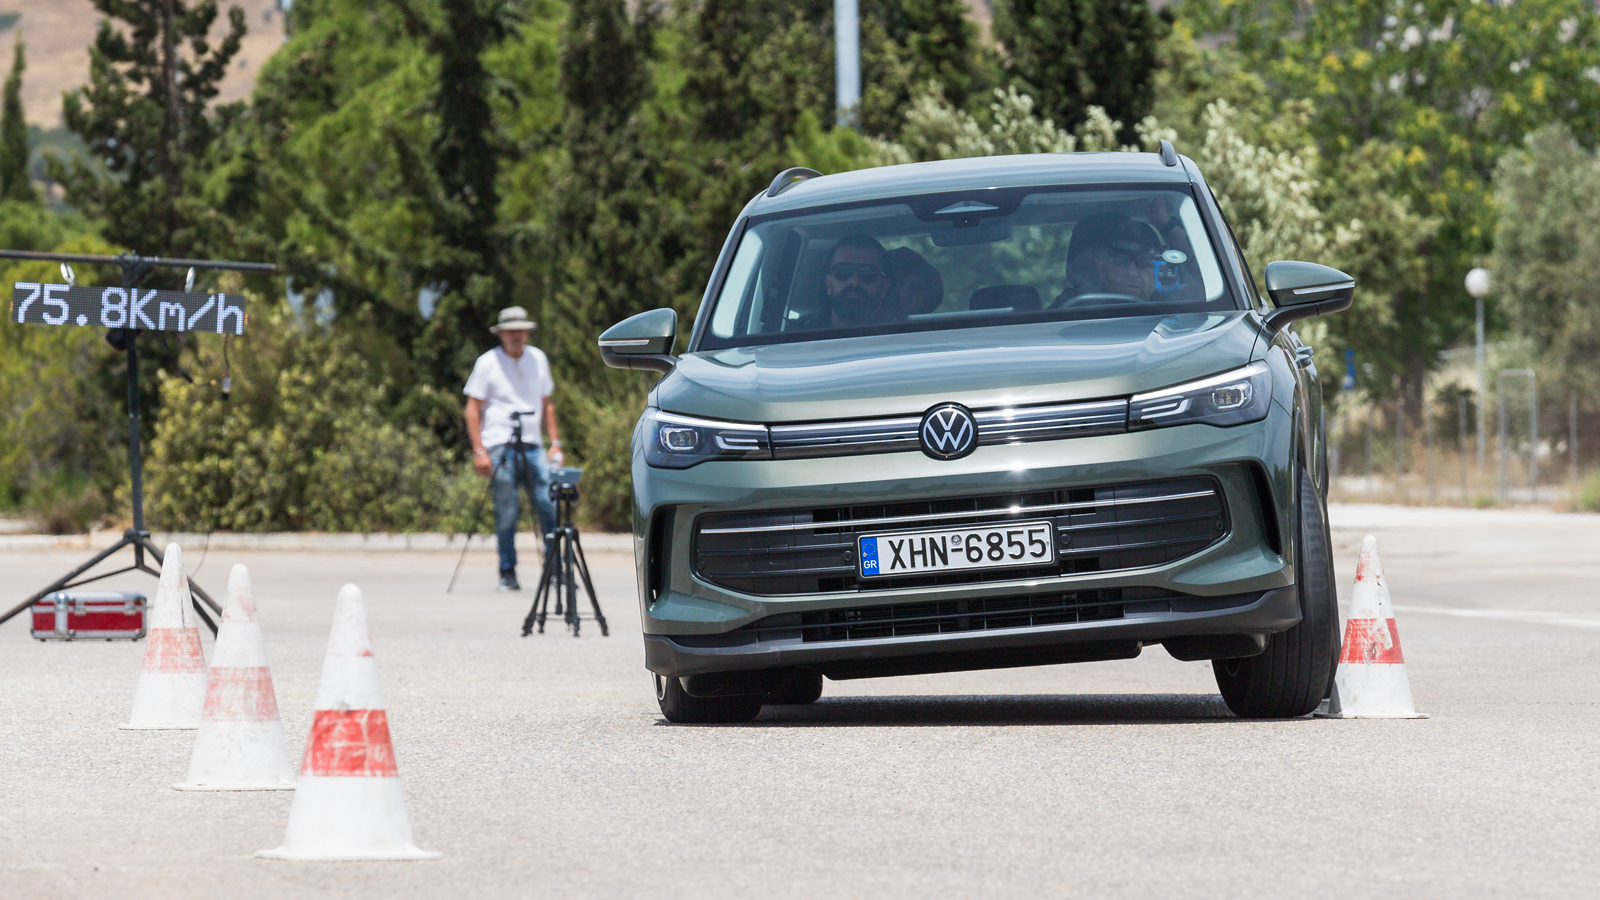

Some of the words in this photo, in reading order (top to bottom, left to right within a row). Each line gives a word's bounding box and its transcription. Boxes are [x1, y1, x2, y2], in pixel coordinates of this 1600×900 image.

[923, 407, 974, 451] VW
[863, 560, 878, 569] GR
[888, 528, 1047, 569] XHN-6855
